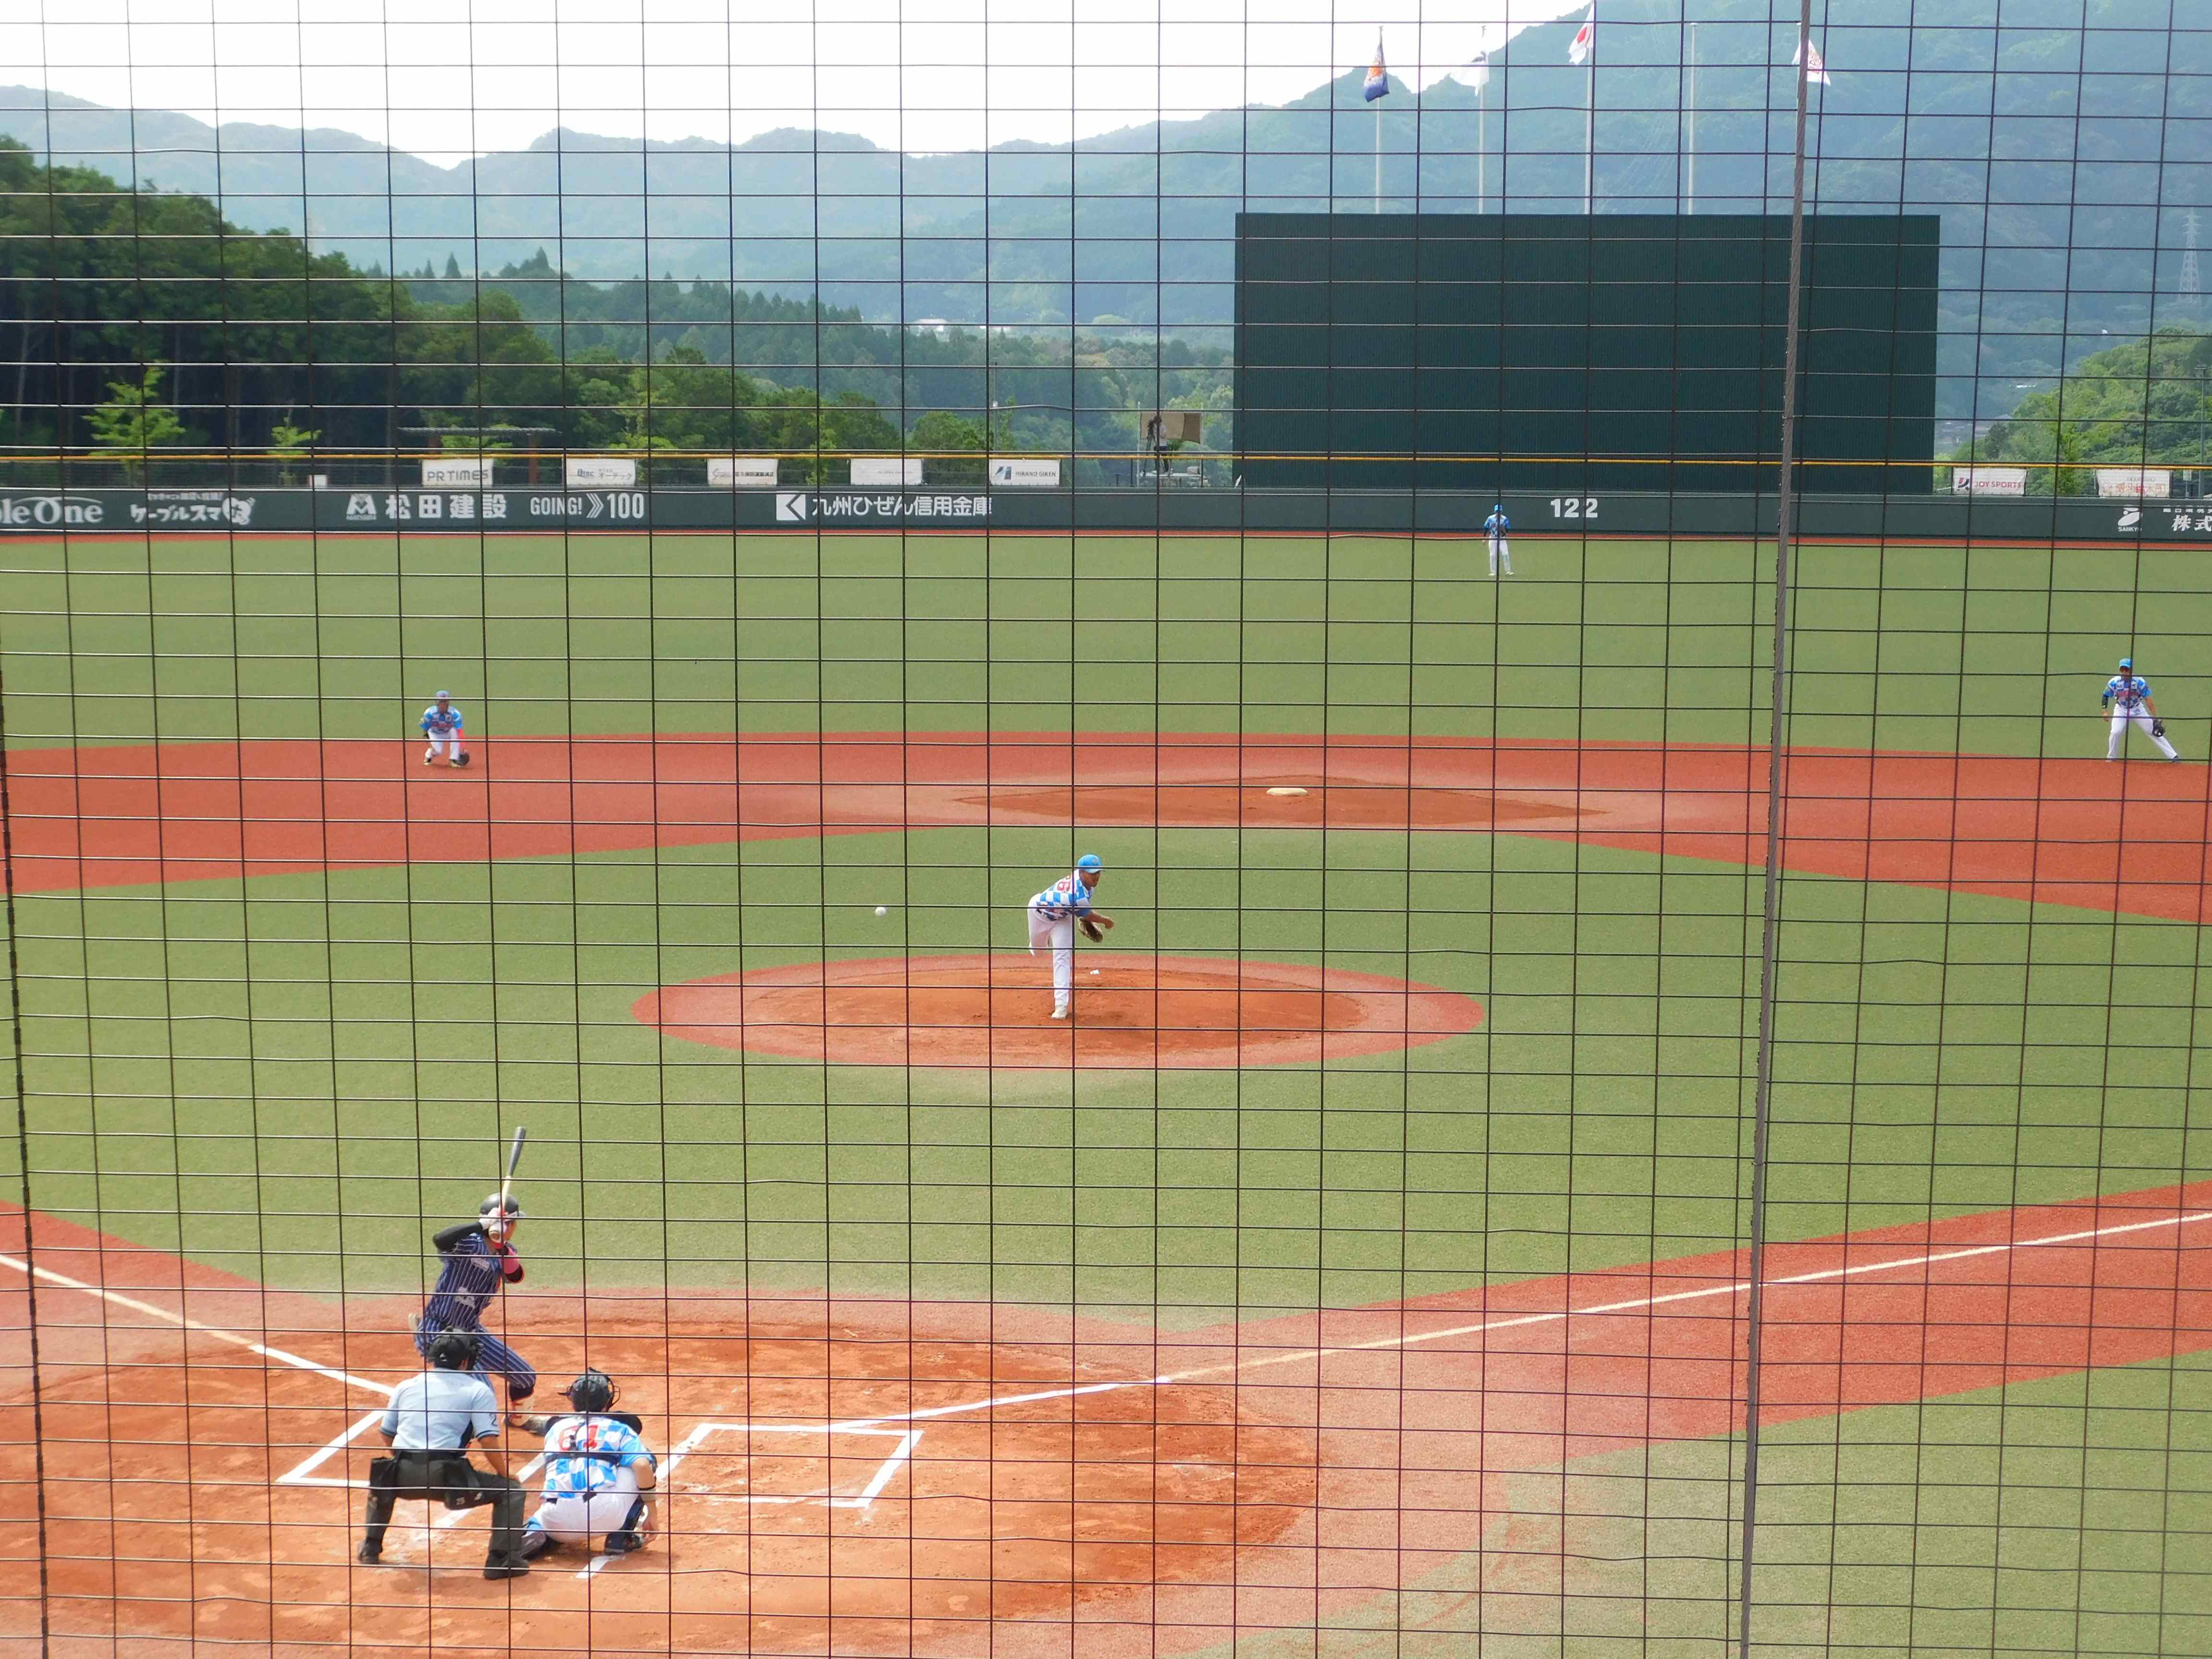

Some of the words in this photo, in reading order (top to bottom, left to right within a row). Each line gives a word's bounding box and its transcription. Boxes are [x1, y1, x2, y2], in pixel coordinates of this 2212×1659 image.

[427, 470, 445, 481] PR
[447, 469, 489, 481] TIMES
[385, 493, 507, 519] 松田建設
[530, 496, 583, 515] GOING!
[606, 493, 644, 518] 100
[812, 495, 992, 517] 九州ひぜん信用金庫
[1551, 498, 1598, 518] 122
